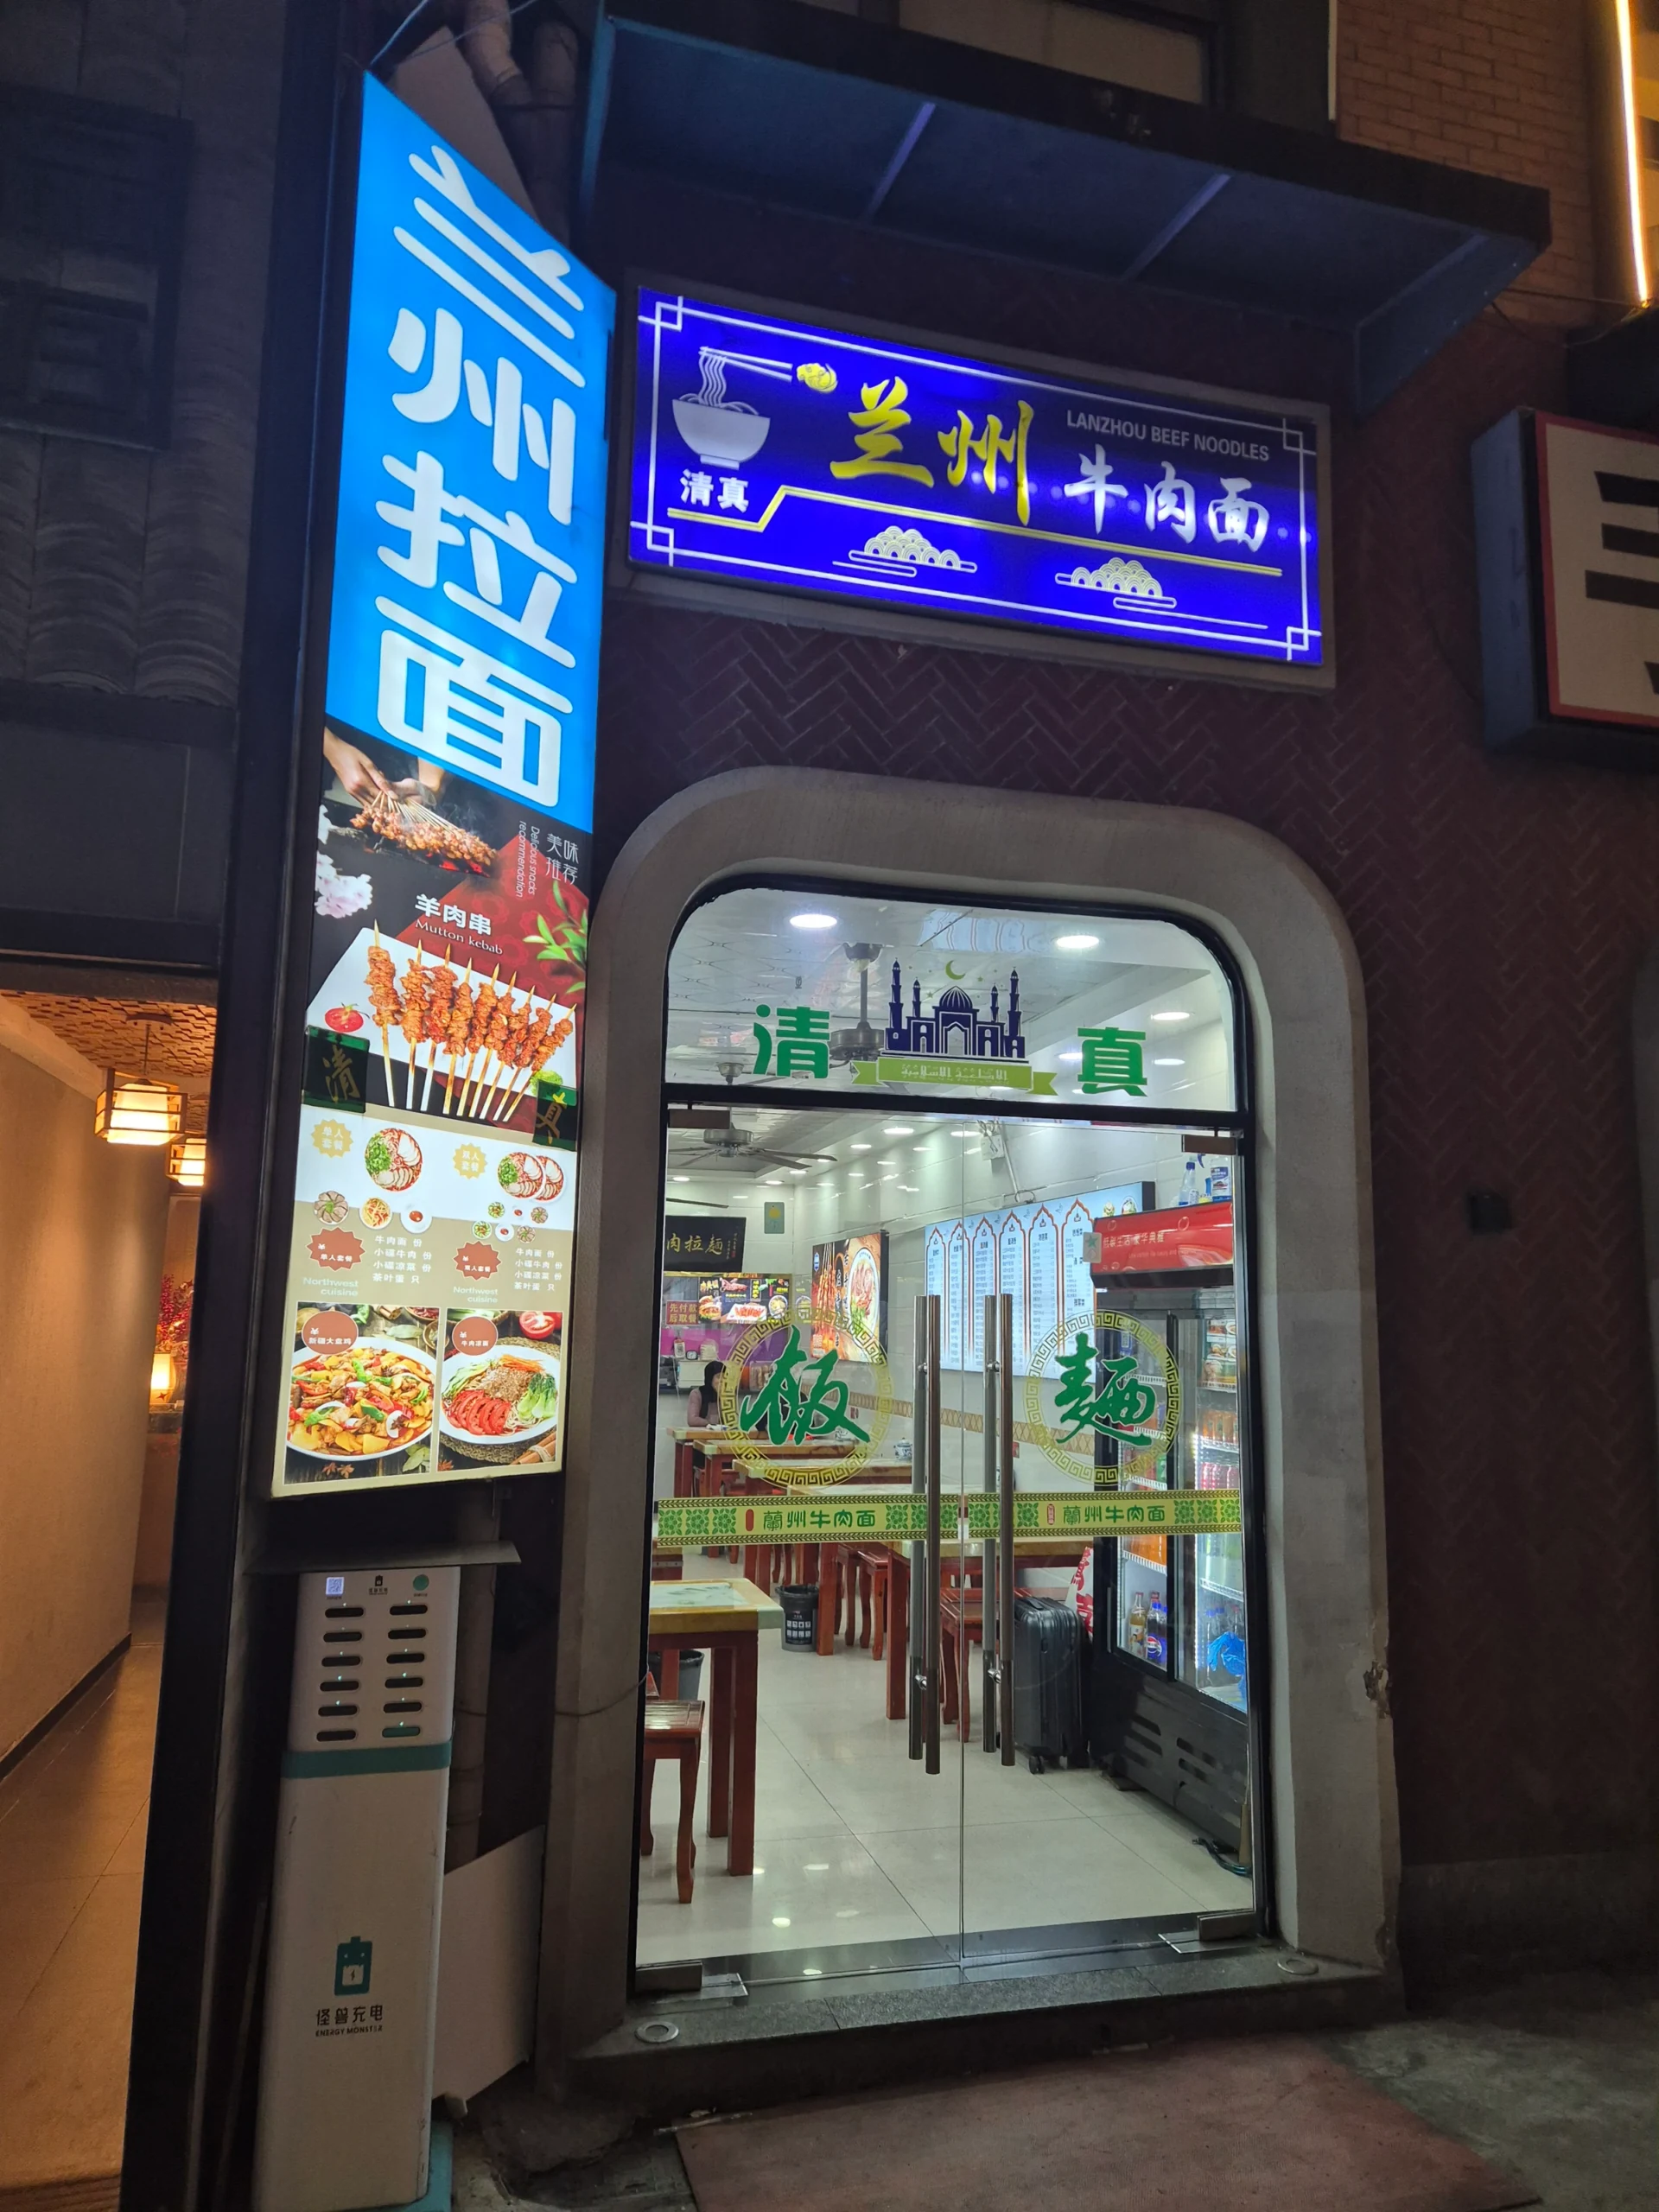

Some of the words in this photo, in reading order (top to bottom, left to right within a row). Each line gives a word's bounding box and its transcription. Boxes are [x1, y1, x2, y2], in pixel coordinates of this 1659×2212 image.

[1066, 410, 1147, 441] LANZHOU
[1151, 425, 1191, 448] BEEF
[1193, 434, 1270, 461] NOODLES
[375, 145, 585, 808] 兰州拉面
[829, 375, 1034, 527] 兰州
[1064, 443, 1270, 553] 牛肉面
[679, 468, 749, 513] 清真
[516, 820, 527, 898] recommendation
[529, 825, 540, 865] Delicious
[546, 832, 579, 864] 美味
[528, 866, 537, 895] snacks
[545, 856, 578, 886] 推荐
[415, 893, 492, 936] 羊肉串
[415, 918, 465, 943] Mutton
[468, 935, 503, 955] kebab
[752, 1003, 830, 1079] 清
[1077, 1026, 1148, 1096] 真
[322, 1044, 361, 1104] 清
[374, 1235, 407, 1247] 牛肉面
[303, 1277, 359, 1288] Northwest
[321, 1287, 358, 1297] cuisine
[453, 1286, 498, 1296] Northwest
[467, 1295, 498, 1304] cuisine
[308, 1337, 352, 1345] 新疆大盘鸡
[763, 1510, 876, 1532] 蘭州牛肉面
[1063, 1504, 1166, 1526] 蘭州牛肉面
[316, 2005, 383, 2026] 怪兽充电
[315, 2028, 345, 2037] ENERGY
